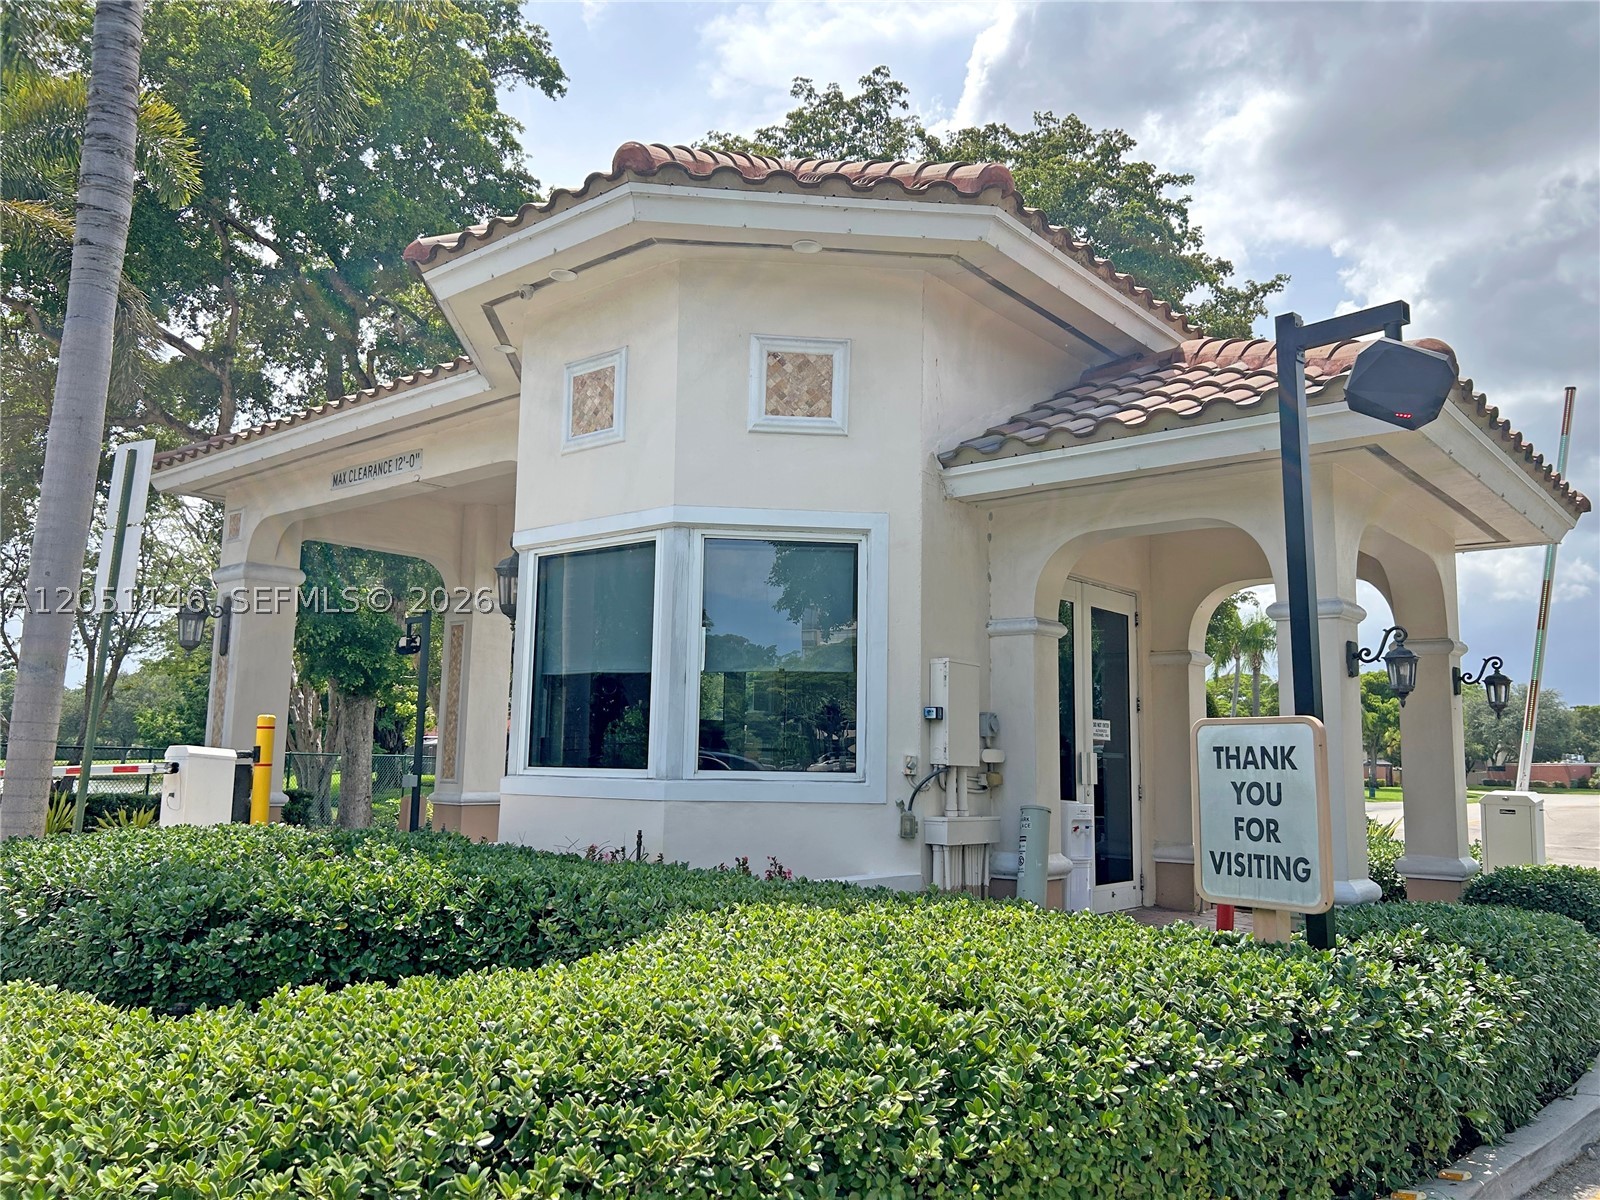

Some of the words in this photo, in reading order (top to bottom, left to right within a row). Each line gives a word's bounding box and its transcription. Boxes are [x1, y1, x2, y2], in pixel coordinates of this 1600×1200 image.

[332, 472, 347, 487] MAX
[348, 460, 392, 483] CLEARANCE
[395, 453, 420, 471] 12'-0"
[1212, 745, 1298, 770] THANK
[1231, 781, 1282, 806] YOU
[1234, 816, 1281, 843] FOR
[1209, 851, 1311, 883] VISITING
